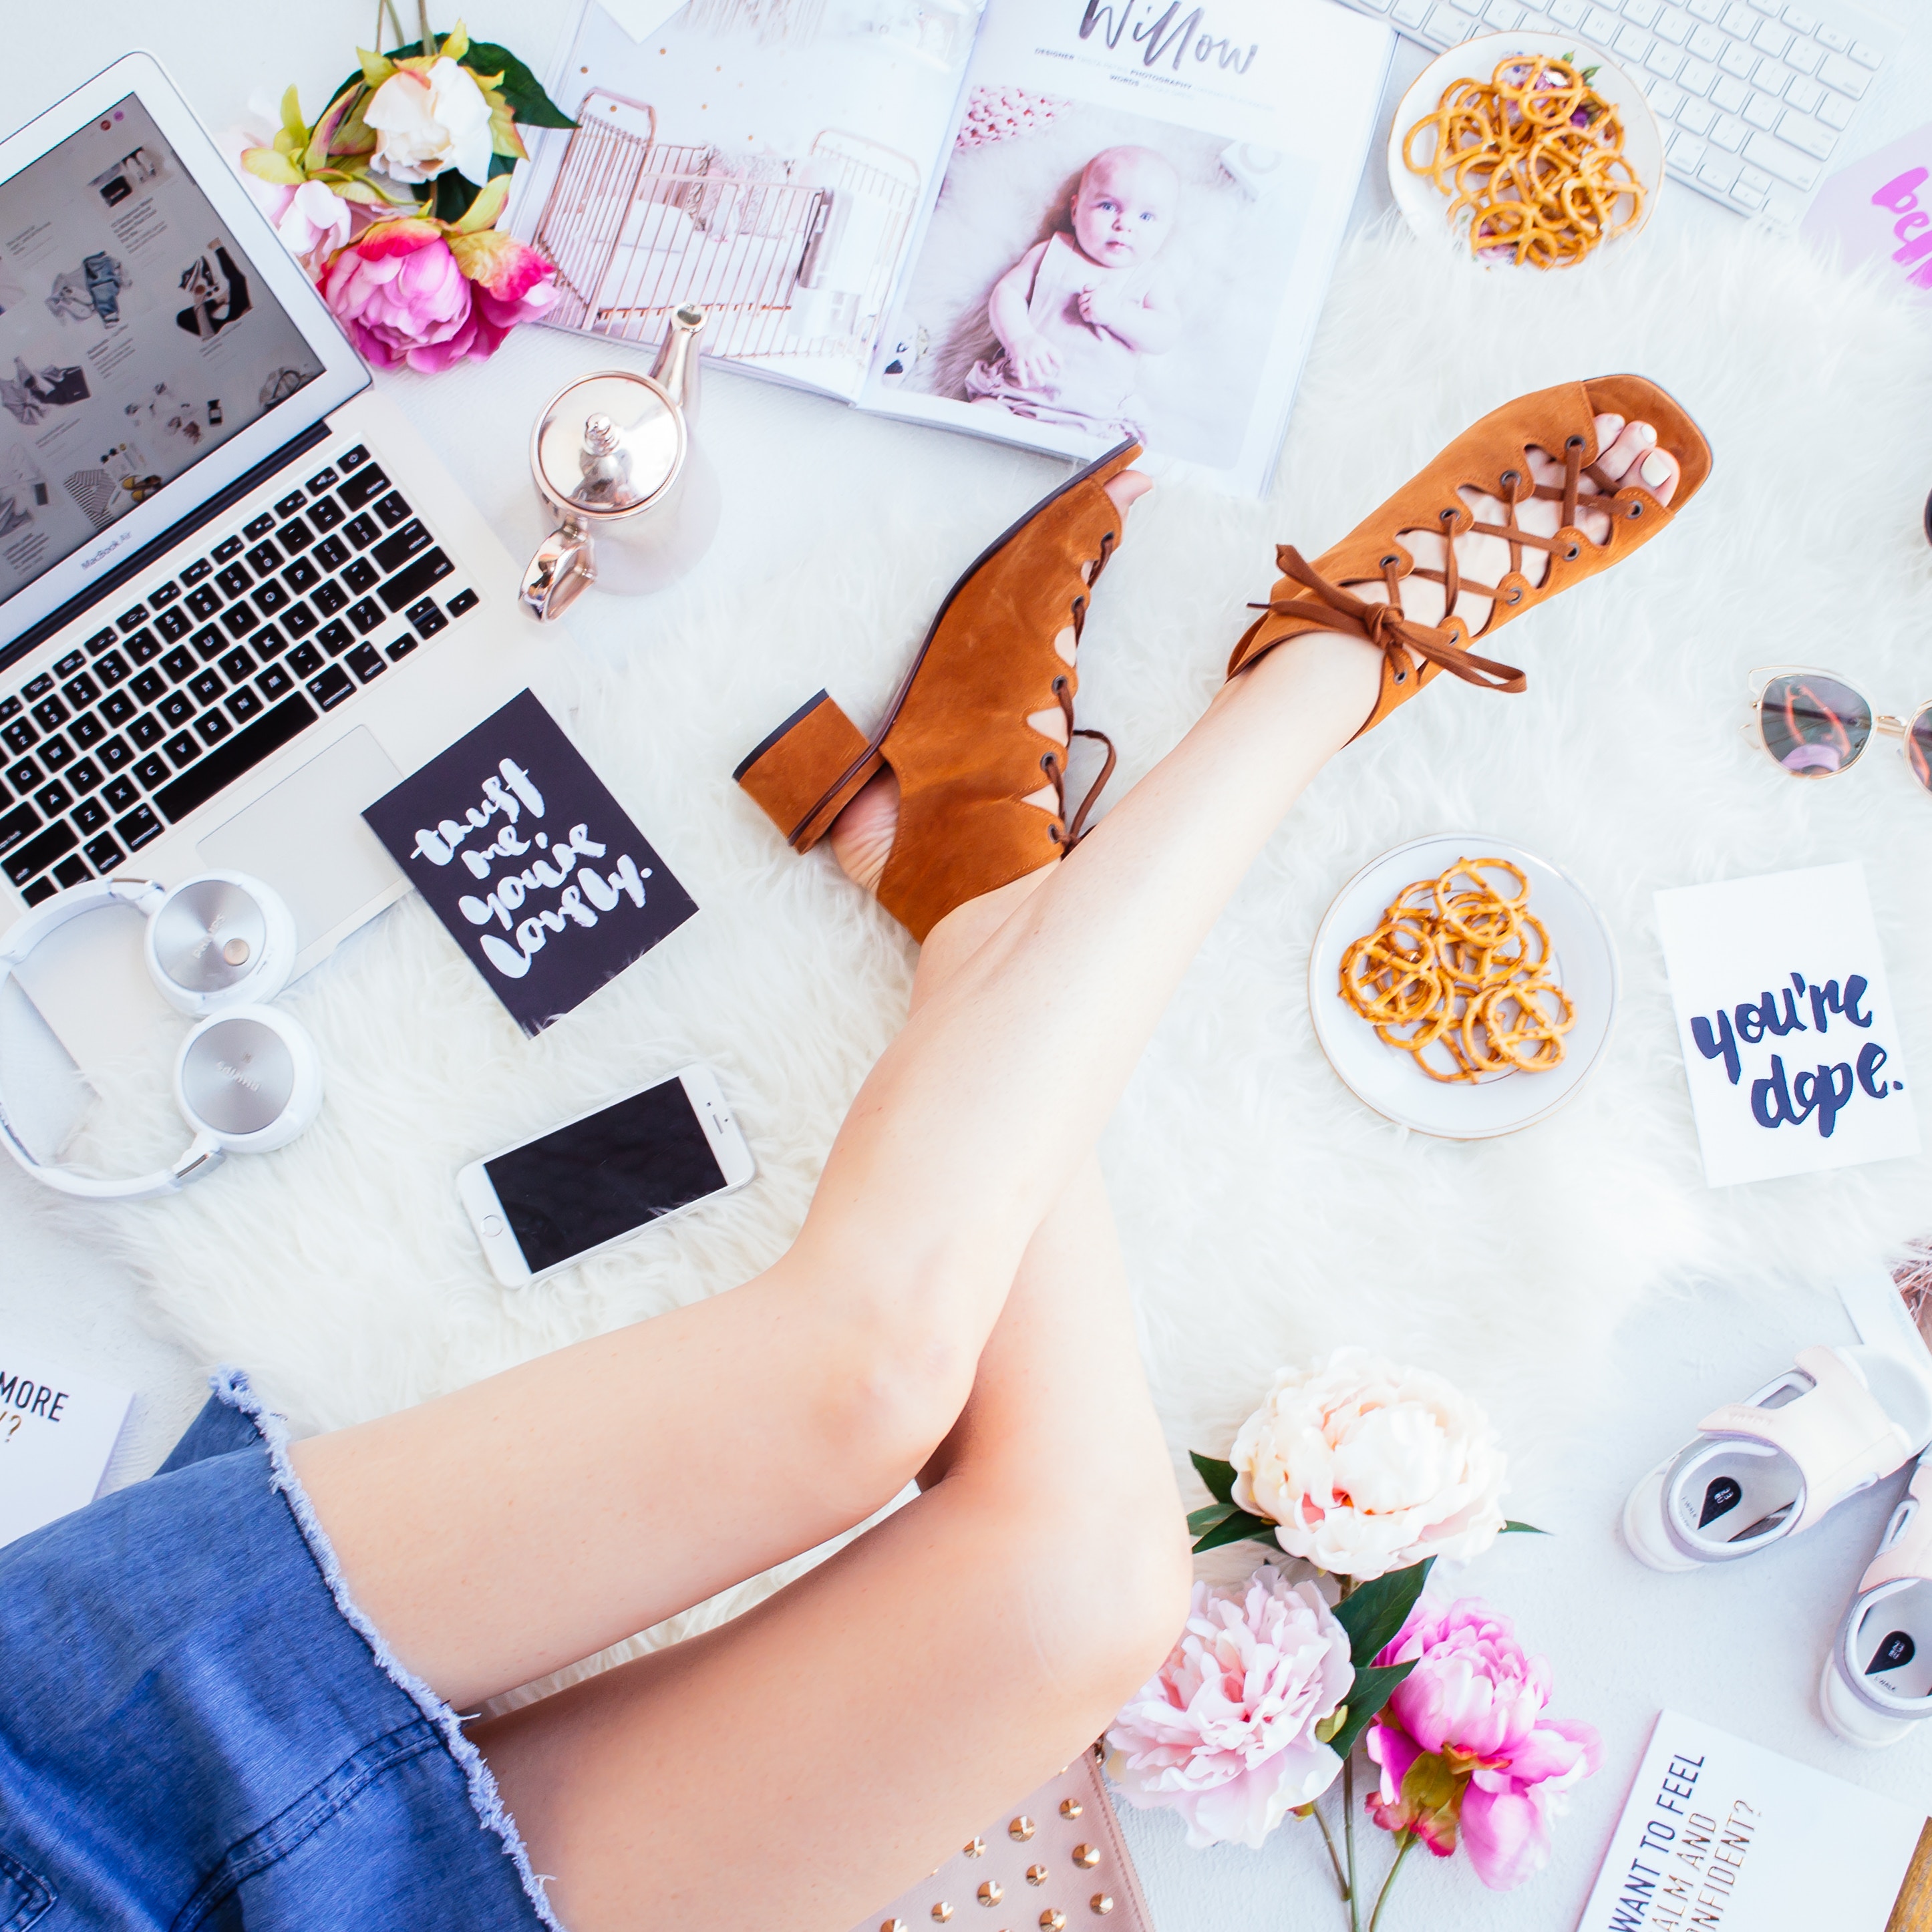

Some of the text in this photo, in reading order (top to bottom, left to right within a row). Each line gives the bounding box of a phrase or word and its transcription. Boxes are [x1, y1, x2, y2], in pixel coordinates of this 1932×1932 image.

[1079, 0, 1258, 74] Willow
[1130, 69, 1192, 90] PHOTOGRAPHY
[365, 479, 385, 495] delete
[408, 535, 428, 550] return
[81, 540, 120, 571] MacBook
[264, 558, 273, 567] 0
[434, 562, 448, 575] shift
[295, 570, 304, 580] P
[233, 581, 241, 589] 9
[265, 593, 276, 603] O
[202, 602, 212, 611] 8
[236, 615, 244, 623] I
[294, 617, 304, 625] L
[172, 624, 180, 633] 7
[203, 636, 214, 647] U
[263, 637, 275, 647] K
[142, 647, 150, 655] 6
[173, 659, 182, 668] Y
[235, 660, 243, 669] J
[111, 669, 120, 678] 5
[143, 681, 152, 690] T
[202, 681, 213, 692] H
[269, 676, 281, 688] M
[82, 691, 89, 699] 4
[323, 683, 351, 706] command
[112, 703, 122, 713] R
[238, 698, 249, 709] N
[172, 704, 182, 714] G
[49, 713, 59, 723] 3
[82, 726, 92, 736] E
[141, 726, 149, 736] F
[208, 721, 218, 732] B
[19, 736, 28, 746] 2
[49, 747, 62, 759] W
[176, 744, 186, 753] V
[110, 749, 121, 760] D
[21, 770, 31, 780] Q
[147, 766, 157, 776] C
[79, 772, 90, 782] S
[116, 788, 127, 799] X
[49, 794, 59, 804] A
[85, 811, 96, 822] Z
[131, 823, 160, 846] command
[15, 867, 30, 881] shift
[480, 854, 653, 979] lovely.
[1690, 972, 1873, 1086] you're
[1750, 1041, 1903, 1138] dope.
[0, 1370, 69, 1422] MORE
[1609, 1753, 1706, 1932] WANT TO FEEL
[1650, 1812, 1717, 1932] ALM AND
